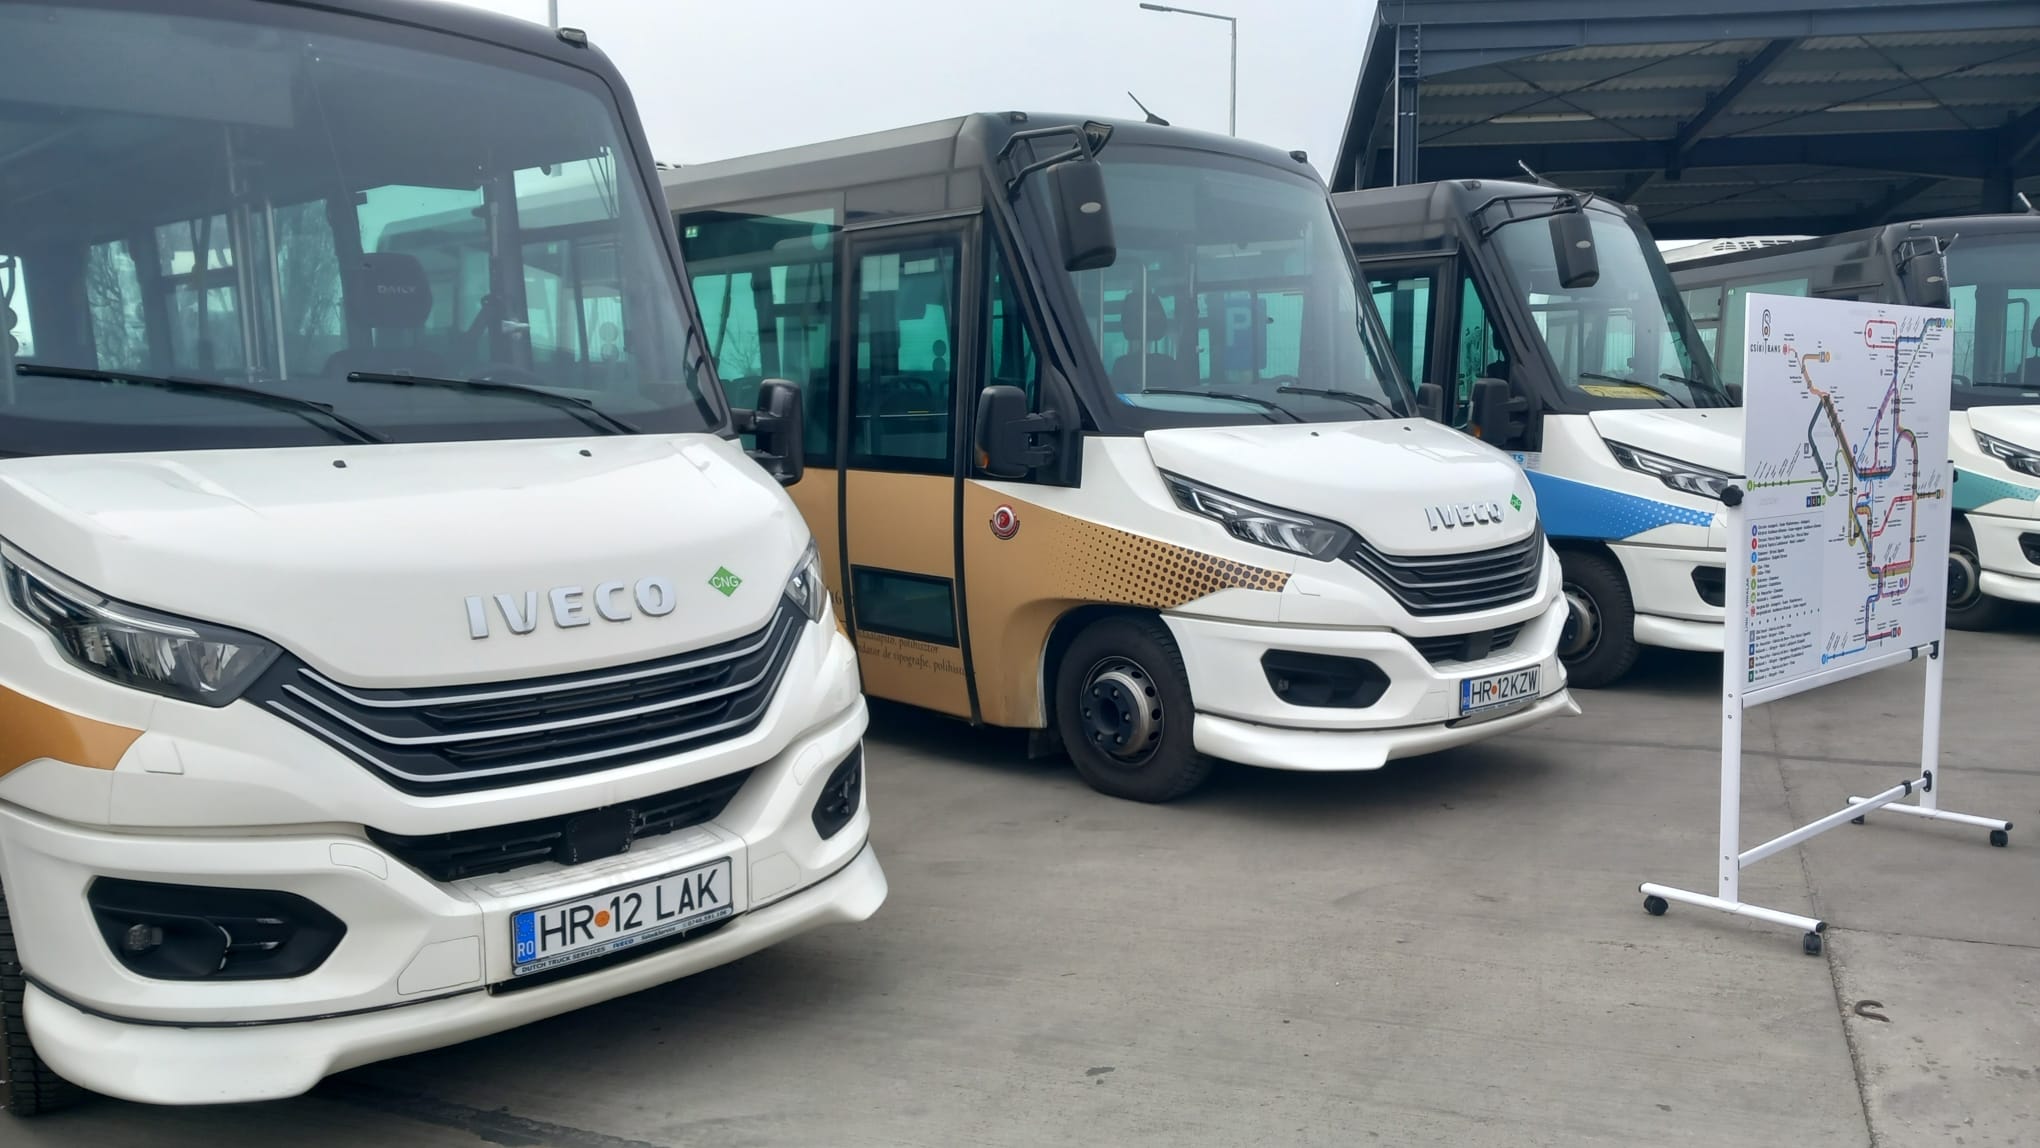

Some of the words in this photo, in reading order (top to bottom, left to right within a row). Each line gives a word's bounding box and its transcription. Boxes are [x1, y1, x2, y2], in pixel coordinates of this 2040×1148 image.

[1424, 502, 1504, 531] IVECO
[712, 573, 739, 589] CNG
[464, 576, 677, 640] IVECO
[1471, 680, 1492, 705] HR
[540, 904, 595, 952] HR
[655, 868, 719, 921] LAK
[517, 940, 535, 958] RO
[521, 960, 546, 973] DUTCH
[548, 955, 571, 966] TRUCK
[572, 946, 605, 960] SERVICES
